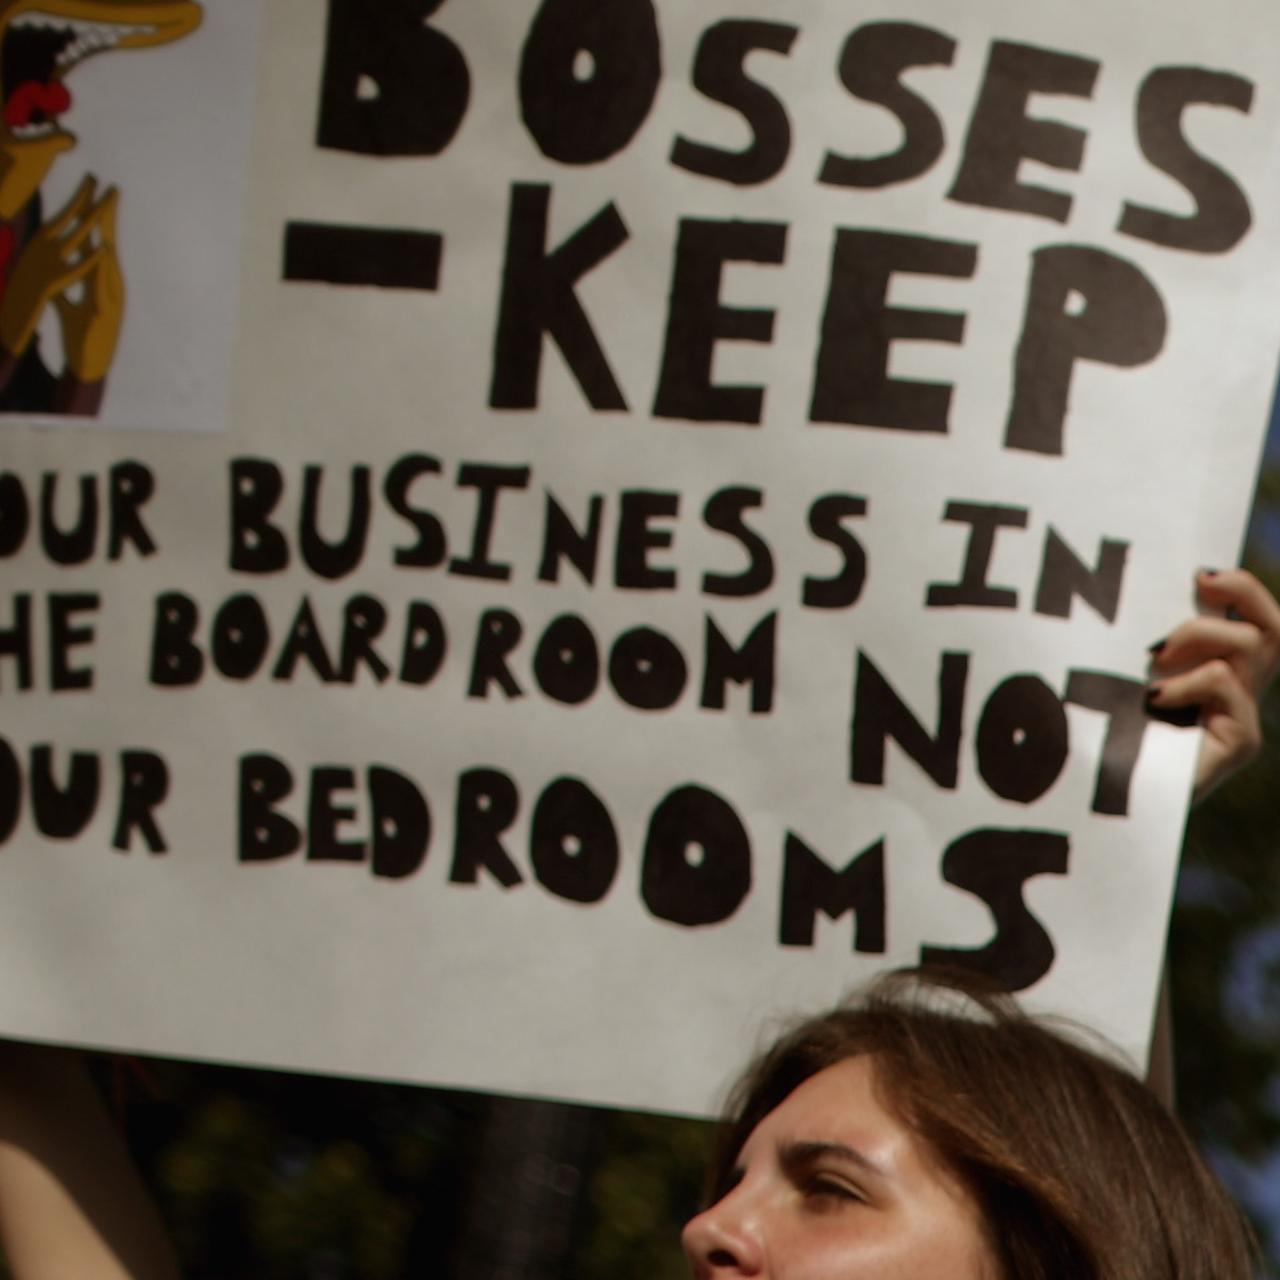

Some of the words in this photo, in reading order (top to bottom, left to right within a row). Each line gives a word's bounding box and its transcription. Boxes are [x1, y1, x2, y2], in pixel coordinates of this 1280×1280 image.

[314, 0, 1255, 256] BOSSES
[228, 454, 868, 608] BUSINESS
[925, 497, 1130, 626] IN
[148, 590, 779, 714] BOARDROOM
[850, 646, 1160, 818] NOT
[236, 748, 1071, 996] BEDROOMS
